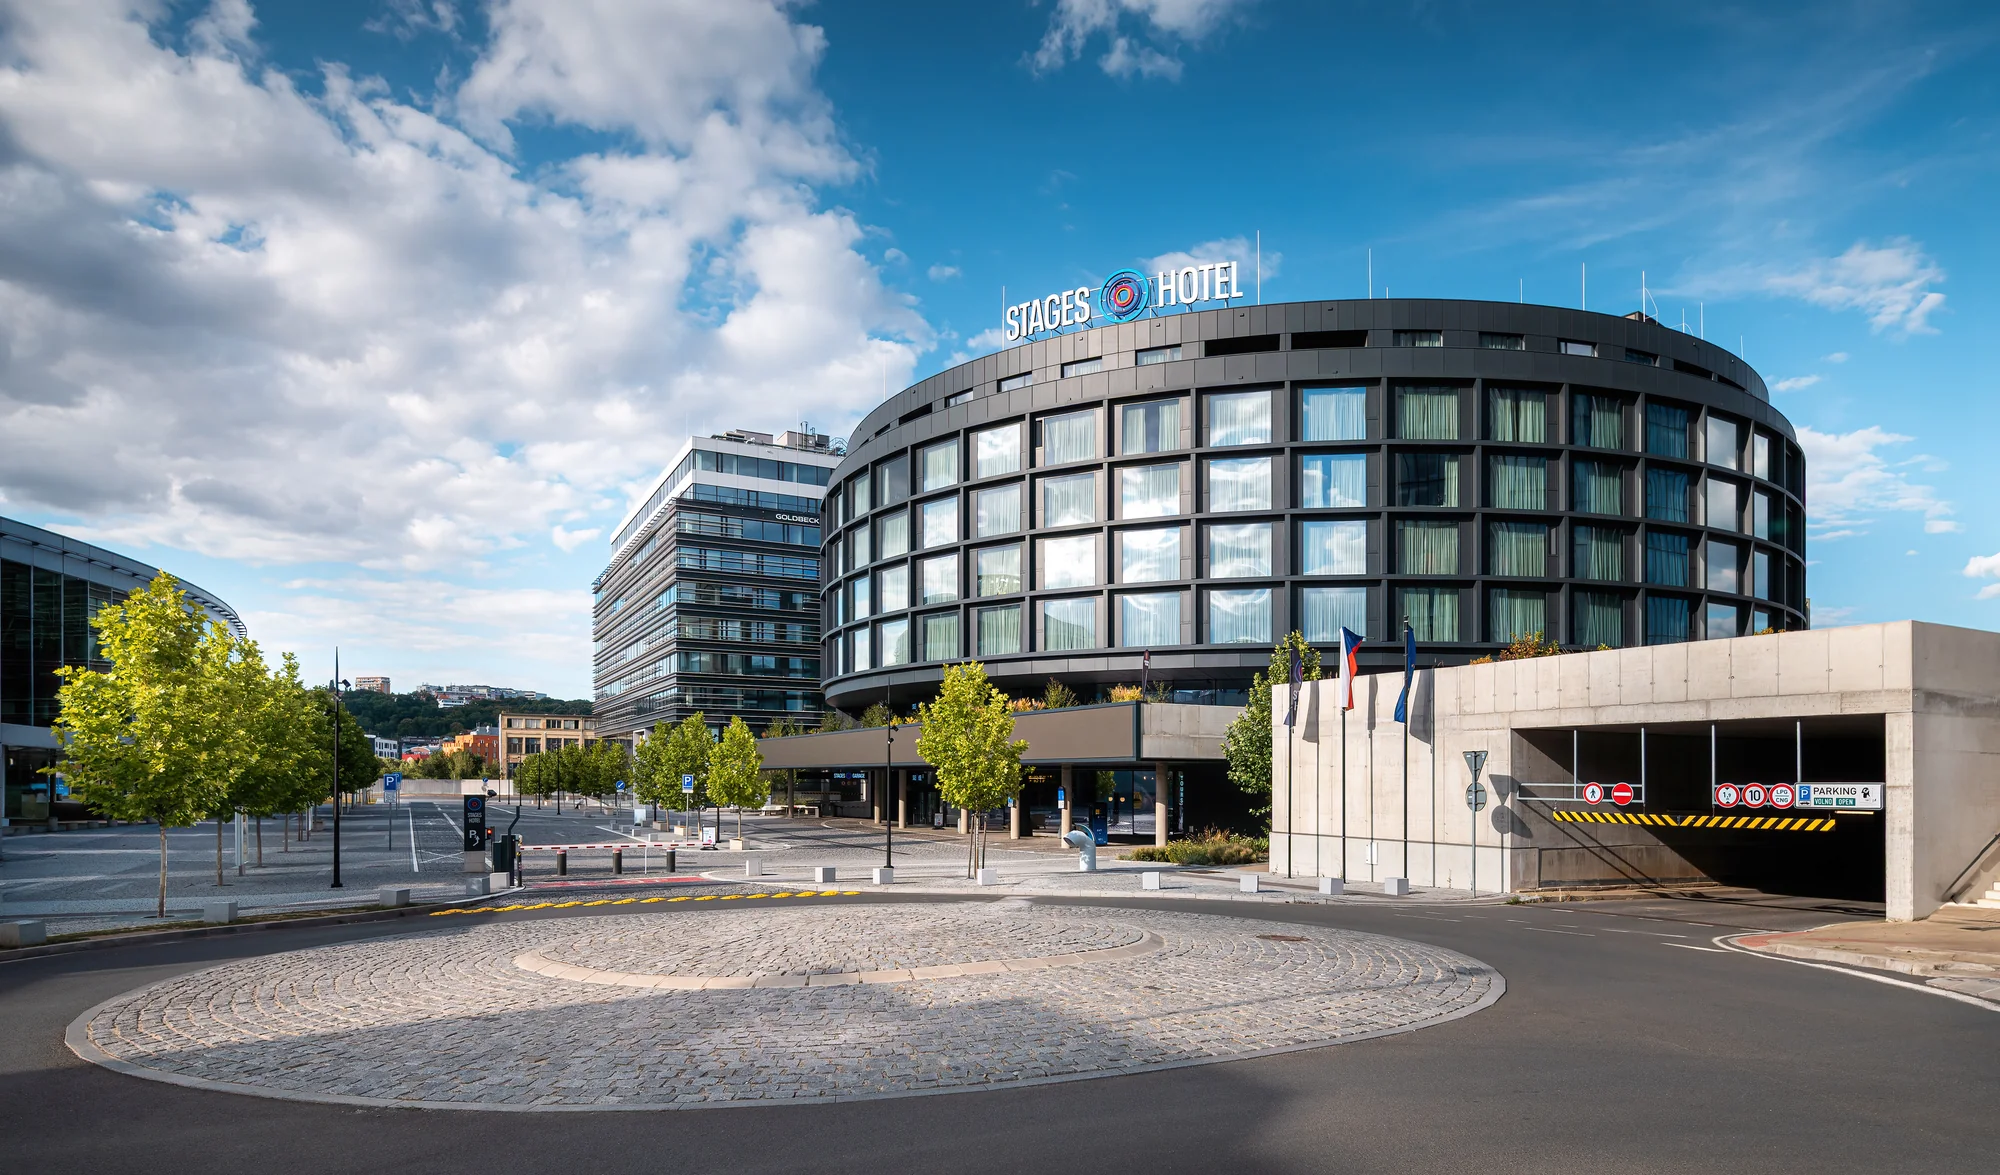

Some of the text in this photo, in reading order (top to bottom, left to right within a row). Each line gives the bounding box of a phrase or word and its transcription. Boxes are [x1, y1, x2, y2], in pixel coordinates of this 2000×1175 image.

[1006, 261, 1243, 341] STAGES HOTEL
[775, 513, 820, 524] GOLDBECK
[386, 776, 394, 786] P
[684, 776, 691, 785] P
[1749, 790, 1761, 801] 10
[1801, 789, 1809, 798] P
[1813, 787, 1857, 795] PARKING
[469, 829, 477, 839] P
